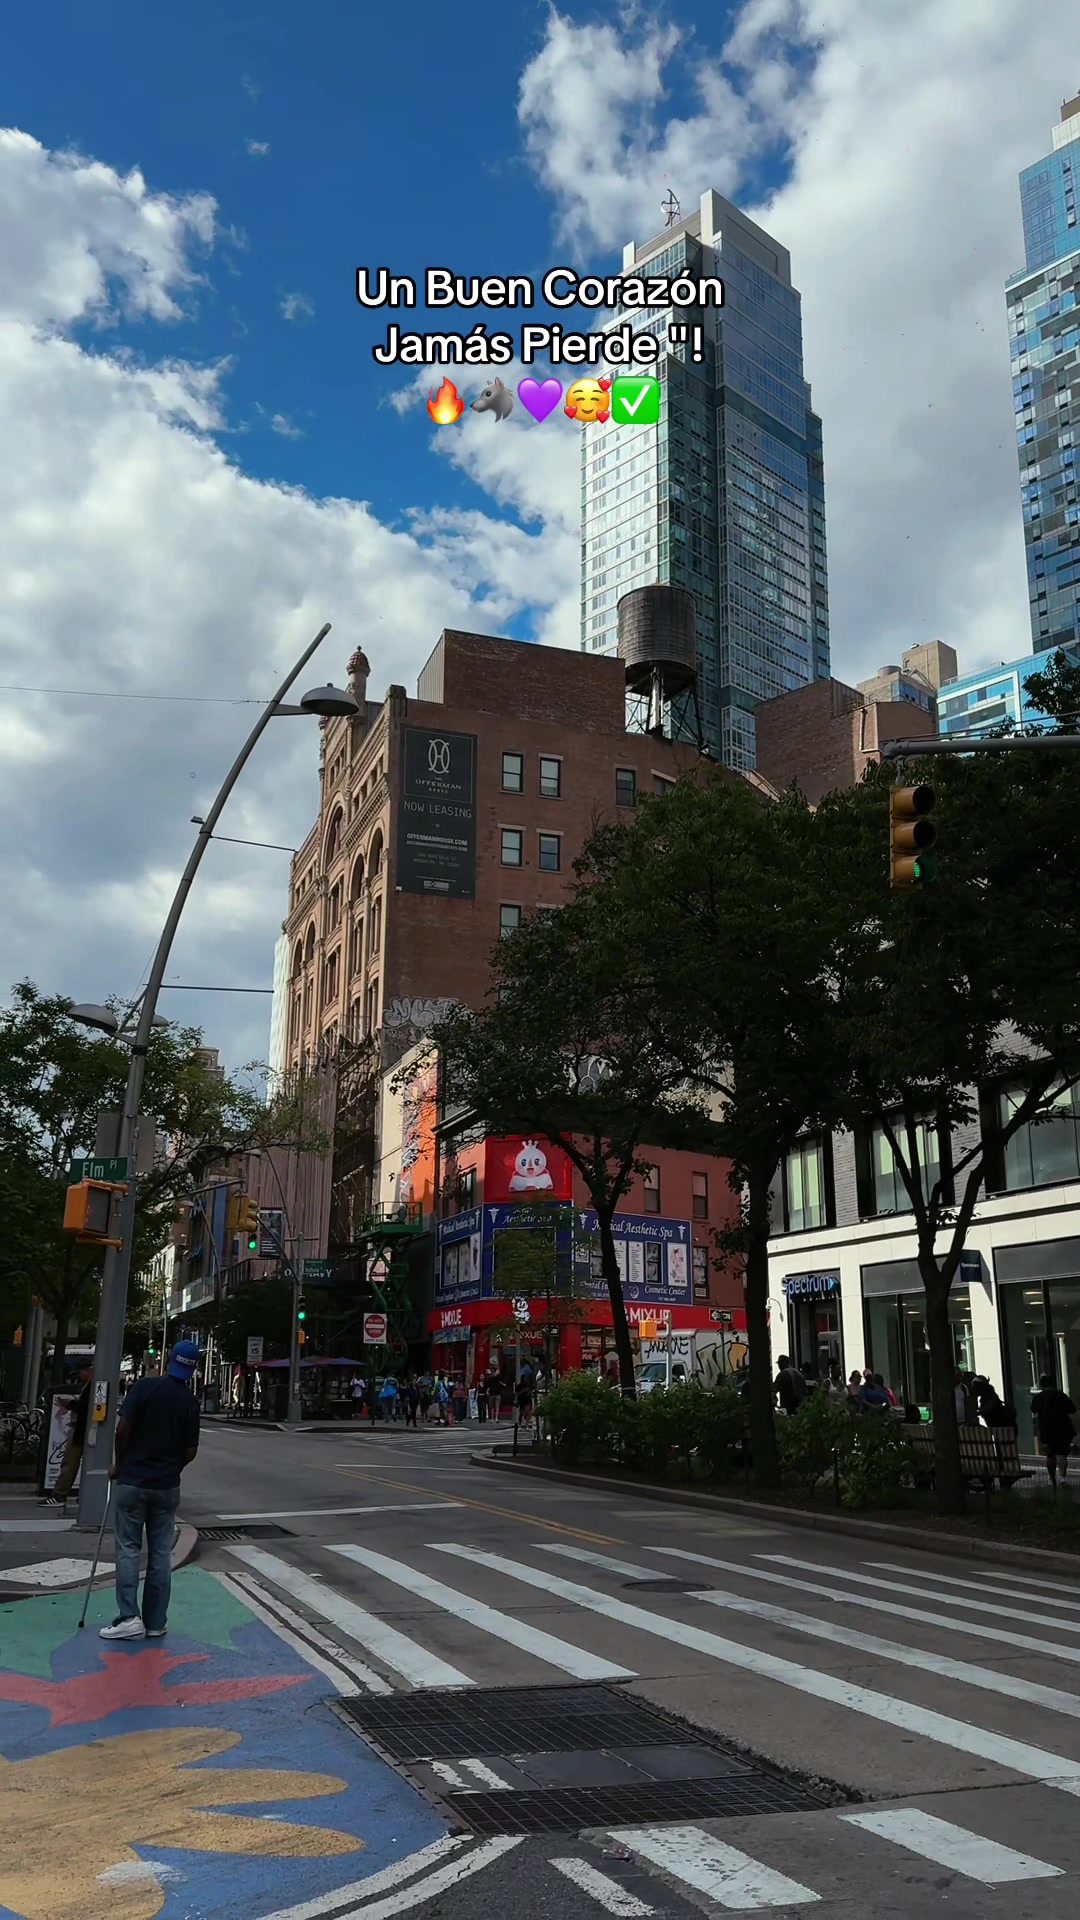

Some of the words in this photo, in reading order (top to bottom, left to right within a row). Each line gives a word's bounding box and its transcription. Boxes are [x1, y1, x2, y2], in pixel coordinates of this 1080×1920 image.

[415, 778, 462, 790] OFFERMAN
[403, 800, 425, 812] NOW
[429, 803, 472, 819] LEASING
[82, 1161, 104, 1178] Elm
[109, 1159, 117, 1169] Pl
[623, 1222, 658, 1236] Aesthetic
[658, 1226, 673, 1240] Spa
[644, 1285, 668, 1295] Cosmetic
[668, 1286, 687, 1296] Center
[781, 1275, 831, 1297] Spectrum
[251, 1347, 259, 1355] 15
